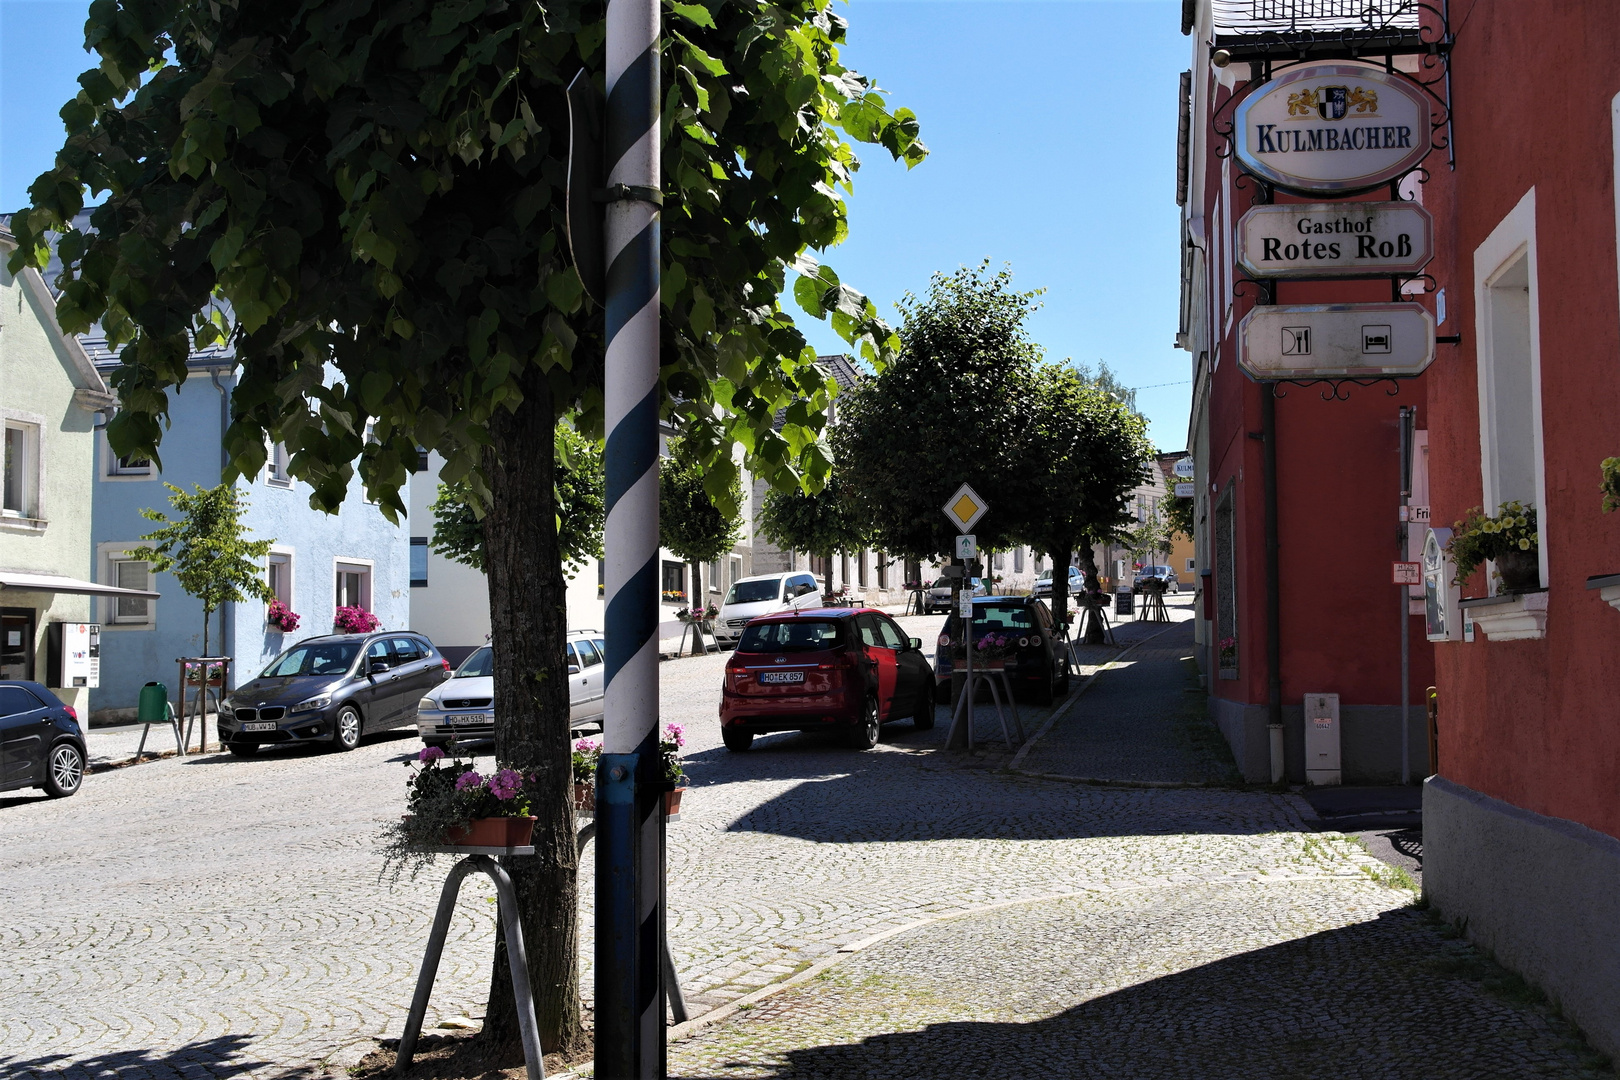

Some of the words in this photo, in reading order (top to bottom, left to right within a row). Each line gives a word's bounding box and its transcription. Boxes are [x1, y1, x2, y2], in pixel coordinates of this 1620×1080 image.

[1256, 124, 1411, 153] KULMBACHER
[1297, 216, 1373, 234] Gasthof
[1261, 236, 1341, 261] Rotes
[1355, 233, 1412, 259] Roß
[1416, 508, 1430, 519] Fri
[764, 673, 774, 681] HO
[778, 673, 788, 681] EK
[789, 673, 803, 681] 857
